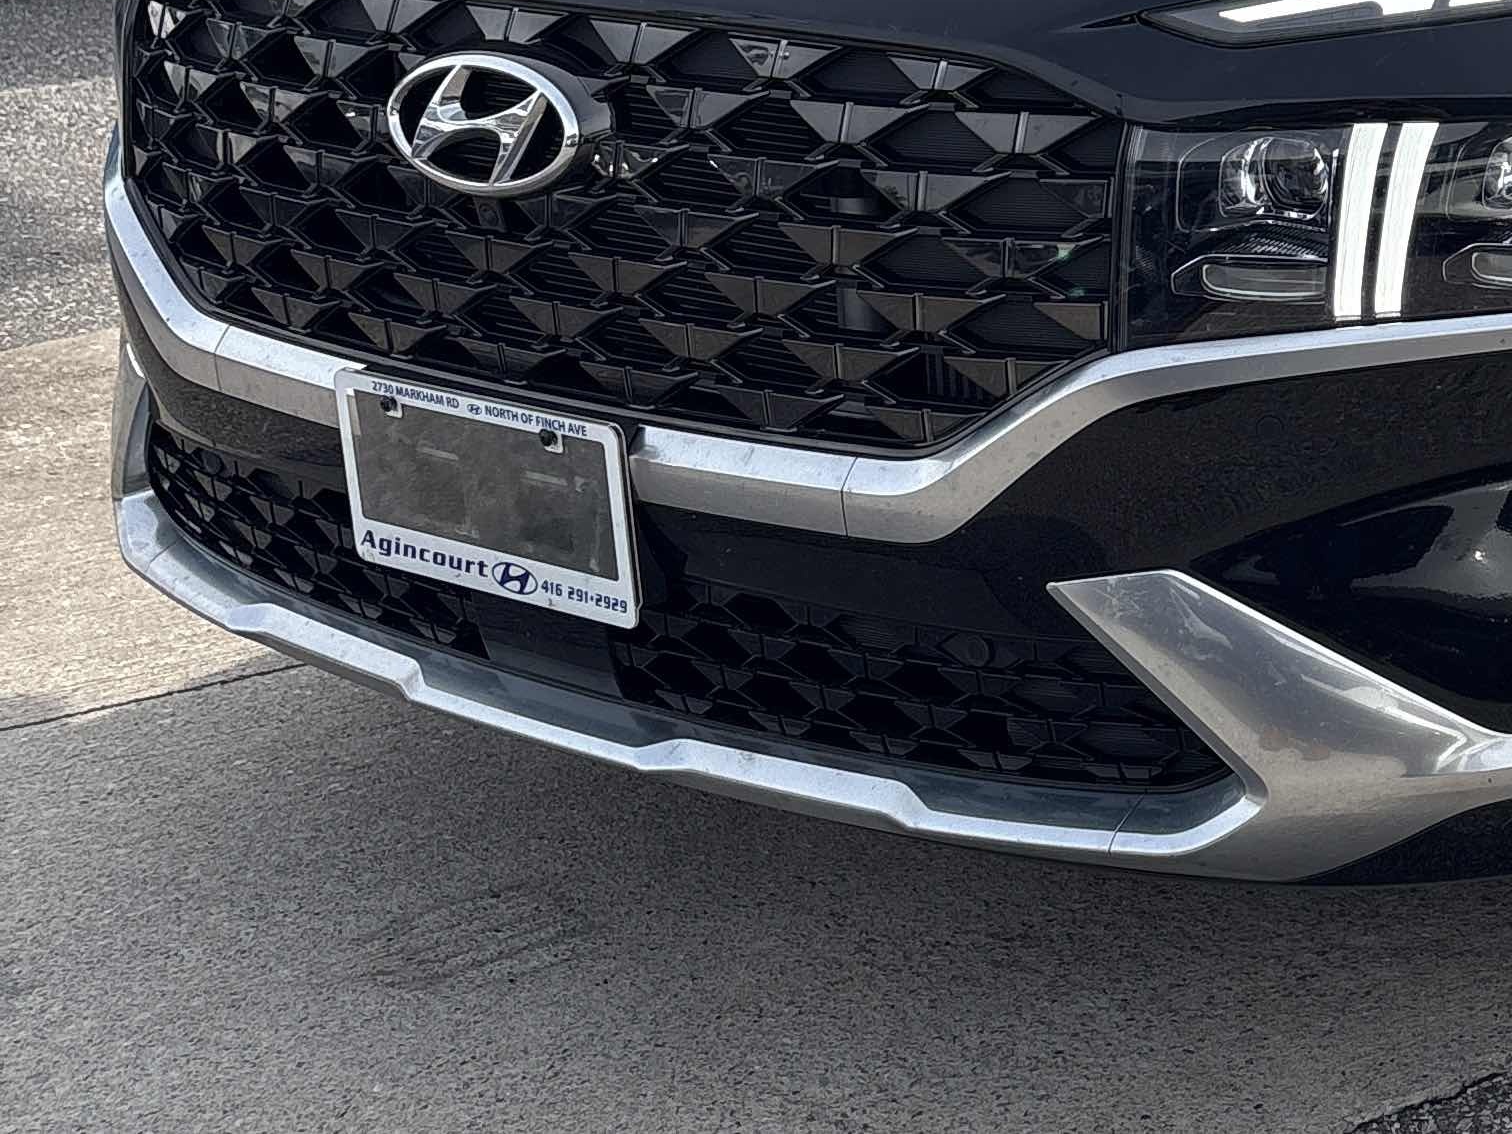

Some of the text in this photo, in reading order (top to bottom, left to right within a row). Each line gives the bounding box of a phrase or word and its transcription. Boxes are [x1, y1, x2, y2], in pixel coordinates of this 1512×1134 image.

[371, 380, 460, 409] 2730 MARKHAM RD
[484, 405, 588, 437] NORTH OF FINCH AVE
[360, 529, 489, 578] Agincourt
[541, 579, 563, 597] 416
